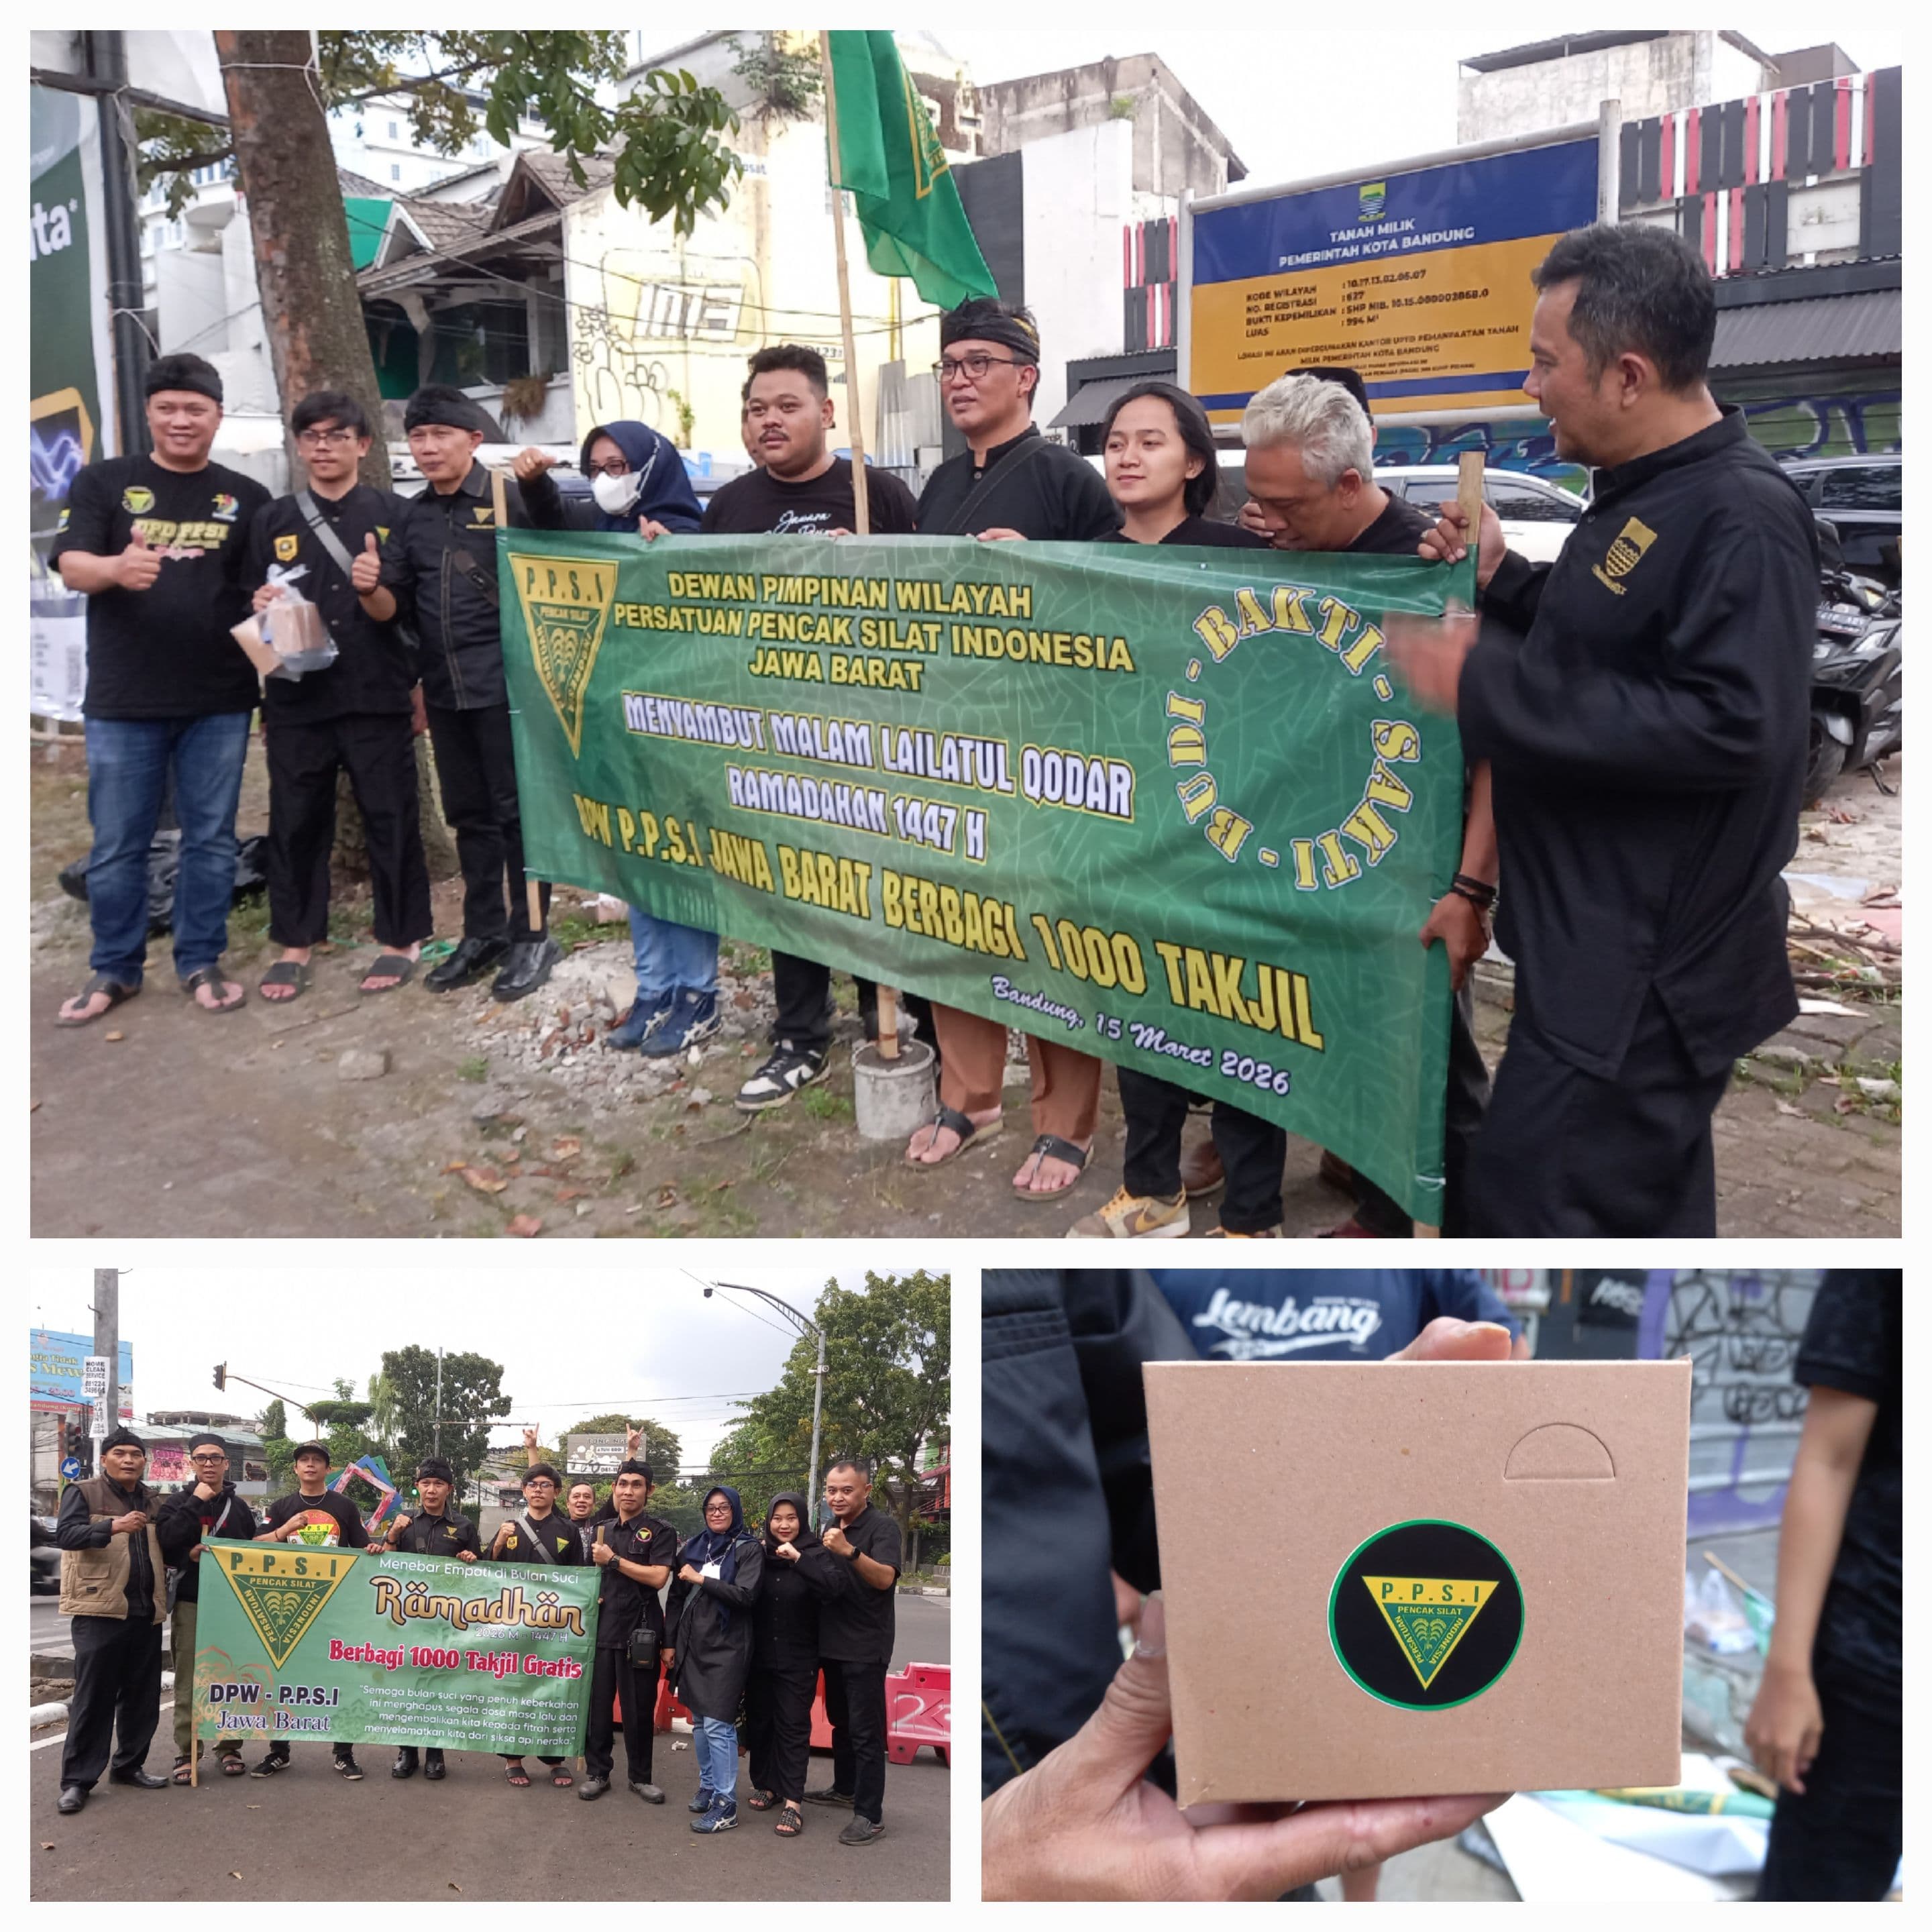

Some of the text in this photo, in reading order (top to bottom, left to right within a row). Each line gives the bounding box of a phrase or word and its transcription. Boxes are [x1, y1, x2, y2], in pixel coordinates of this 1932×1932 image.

[1279, 227, 1474, 268] PEMERINTAH KOTA BANDUNG
[1330, 219, 1415, 242] TANAH MILIK
[1265, 298, 1317, 312] REGISTRASI
[1275, 285, 1317, 299] WILAYAH
[1246, 315, 1272, 326] BUKTI
[1275, 307, 1337, 323] KEPEMILIKAN
[1246, 328, 1269, 337] LUAS
[1397, 345, 1440, 356] BANDUNG
[669, 573, 1032, 619] DEWAN PIMPINAN WILAYAH
[613, 603, 1136, 673] PERSATUAN PENCAK SILAT INDONESIA
[1193, 586, 1385, 675] BAKTI
[749, 647, 924, 692] JAWA BARAT
[622, 691, 1136, 823] MENYAMBUT MALAM LAILATUL QODAR
[1167, 692, 1252, 862] BUDI
[726, 763, 989, 864] RAMADAHAN 1447 H
[1291, 720, 1419, 890] SAKTI
[709, 828, 775, 894] JAWA
[778, 844, 872, 921] BARAT
[881, 867, 1028, 962] BERBAGI
[1031, 912, 1147, 998] 1000
[1155, 940, 1326, 1054] TAKJIL
[992, 975, 1290, 1096] Bandung, 15 Maret 2026
[1192, 1288, 1382, 1345] Lembang
[250, 1577, 316, 1589] PENCAK SILAT
[380, 1557, 578, 1584] Menebar Empati di Bulan Suci
[244, 1589, 276, 1643] PERSATUAN
[283, 1594, 320, 1644] INDONESIA
[1397, 1606, 1462, 1615] PENCAK SILAT
[475, 1627, 504, 1639] 2026
[508, 1629, 519, 1640] M
[531, 1631, 557, 1642] 1447
[559, 1633, 568, 1643] H
[1395, 1615, 1424, 1664] PERSATUAN
[1429, 1617, 1464, 1665] INDONESIA
[329, 1638, 582, 1679] Berbagi 1000 Takjil Gratis
[209, 1684, 260, 1704] DPW
[279, 1685, 339, 1706] P.P.S.I
[370, 1699, 577, 1721] ini menghapus segala dosa masa lalu dan
[407, 1688, 435, 1698] bulan
[438, 1691, 457, 1699] suci
[460, 1693, 484, 1704] yang
[487, 1696, 518, 1705] penuh
[521, 1697, 579, 1709] keberkahan
[216, 1711, 331, 1731] Jawa Barat
[364, 1725, 445, 1737] menyelamatkan
[447, 1730, 466, 1739] kita
[468, 1731, 488, 1740] dari
[491, 1733, 515, 1743] siksa
[518, 1736, 534, 1746] api
[379, 1713, 459, 1725] mengembalikan
[462, 1717, 480, 1727] kita
[483, 1719, 521, 1731] kepada
[523, 1723, 549, 1733] fitrah
